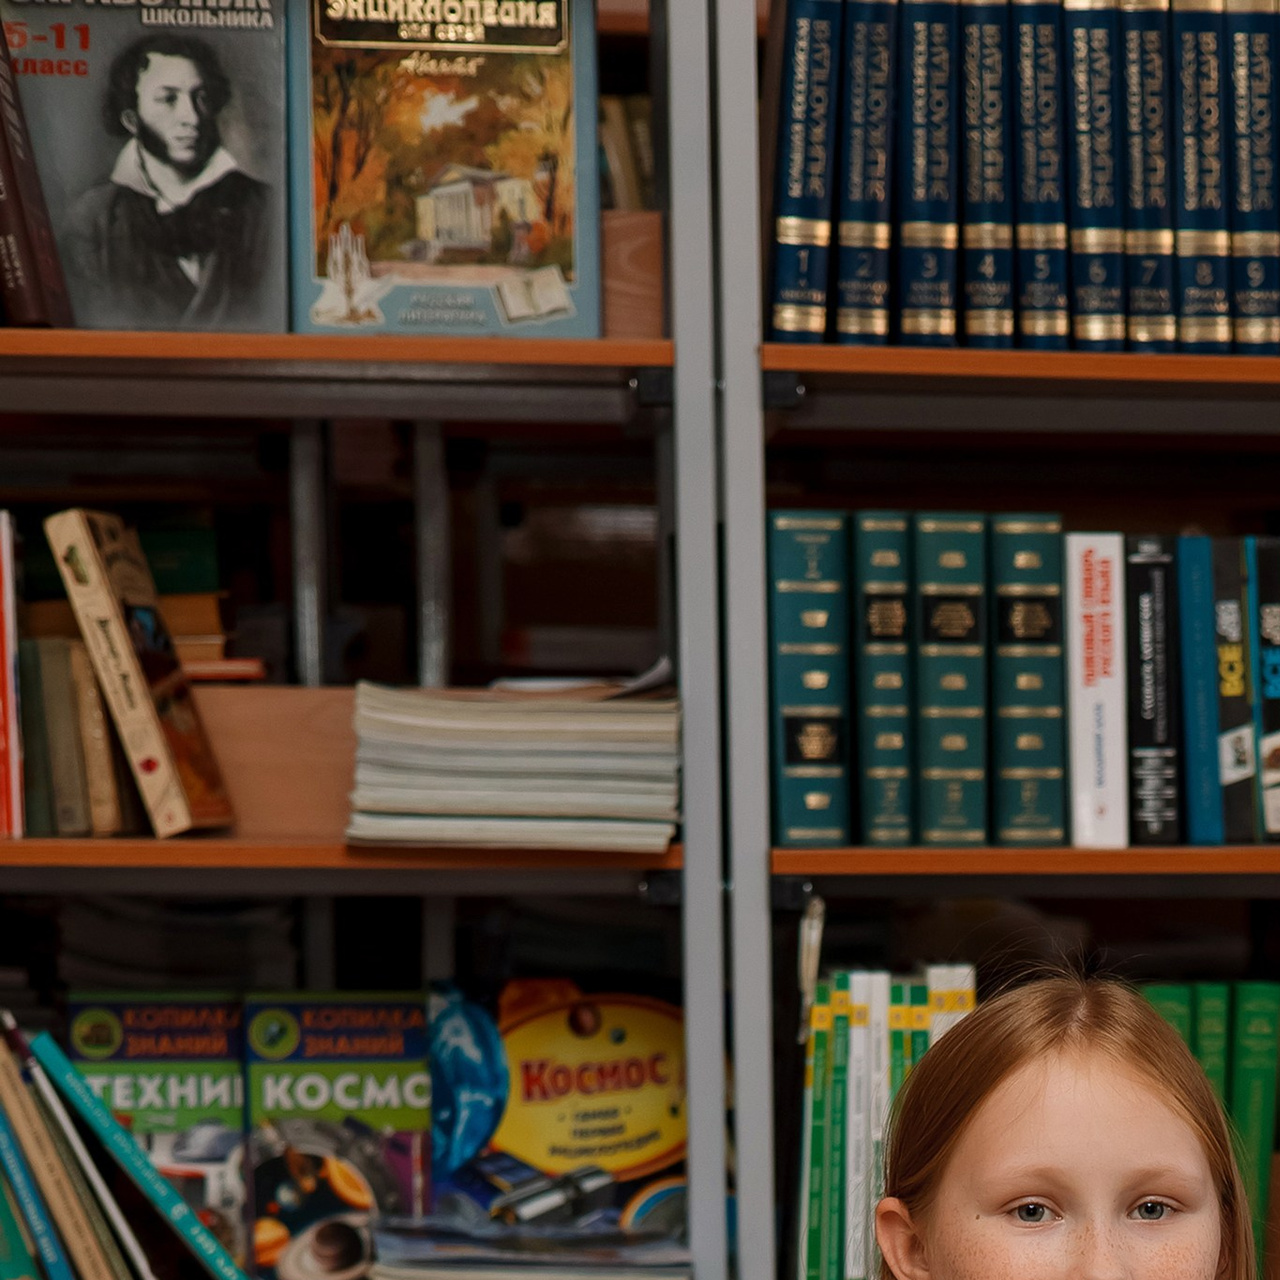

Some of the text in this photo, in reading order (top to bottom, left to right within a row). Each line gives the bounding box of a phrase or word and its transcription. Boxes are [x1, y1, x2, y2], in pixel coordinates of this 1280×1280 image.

[141, 7, 274, 28] ШКОЛЬНИКА
[325, 0, 557, 29] ЭНЦИКЛОПЕДИЯ
[4, 21, 90, 50] 5-11
[807, 19, 830, 197] ЭНЦИКЛОПЕДИЯ
[864, 23, 889, 202] ЭНЦИКЛОПЕДИЯ
[928, 22, 949, 201] ЭНЦИКЛОПЕДИЯ
[982, 24, 1004, 203] ЭНЦИКЛОПЕДИЯ
[1036, 24, 1058, 203] ЭНЦИКЛОПЕДИЯ
[1089, 28, 1114, 207] ЭНЦИКЛОПЕДИЯ
[1142, 30, 1165, 208] ЭНЦИКЛОПЕДИЯ
[1199, 31, 1220, 210] ЭНЦИКЛОПЕДИЯ
[1251, 33, 1273, 211] ЭНЦИКЛОПЕДИЯ
[796, 249, 810, 274] 1
[856, 252, 873, 278] 2
[921, 252, 939, 278] 3
[978, 254, 996, 278] 4
[1033, 254, 1051, 279] 5
[1089, 259, 1108, 282] 6
[1141, 260, 1162, 284] 7
[1195, 262, 1212, 285] 8
[1247, 261, 1265, 287] 9
[126, 1032, 228, 1058] ЗНАНИЙ
[304, 1032, 405, 1059] ЗНАНИЙ
[87, 1073, 244, 1111] ТЕХНИ
